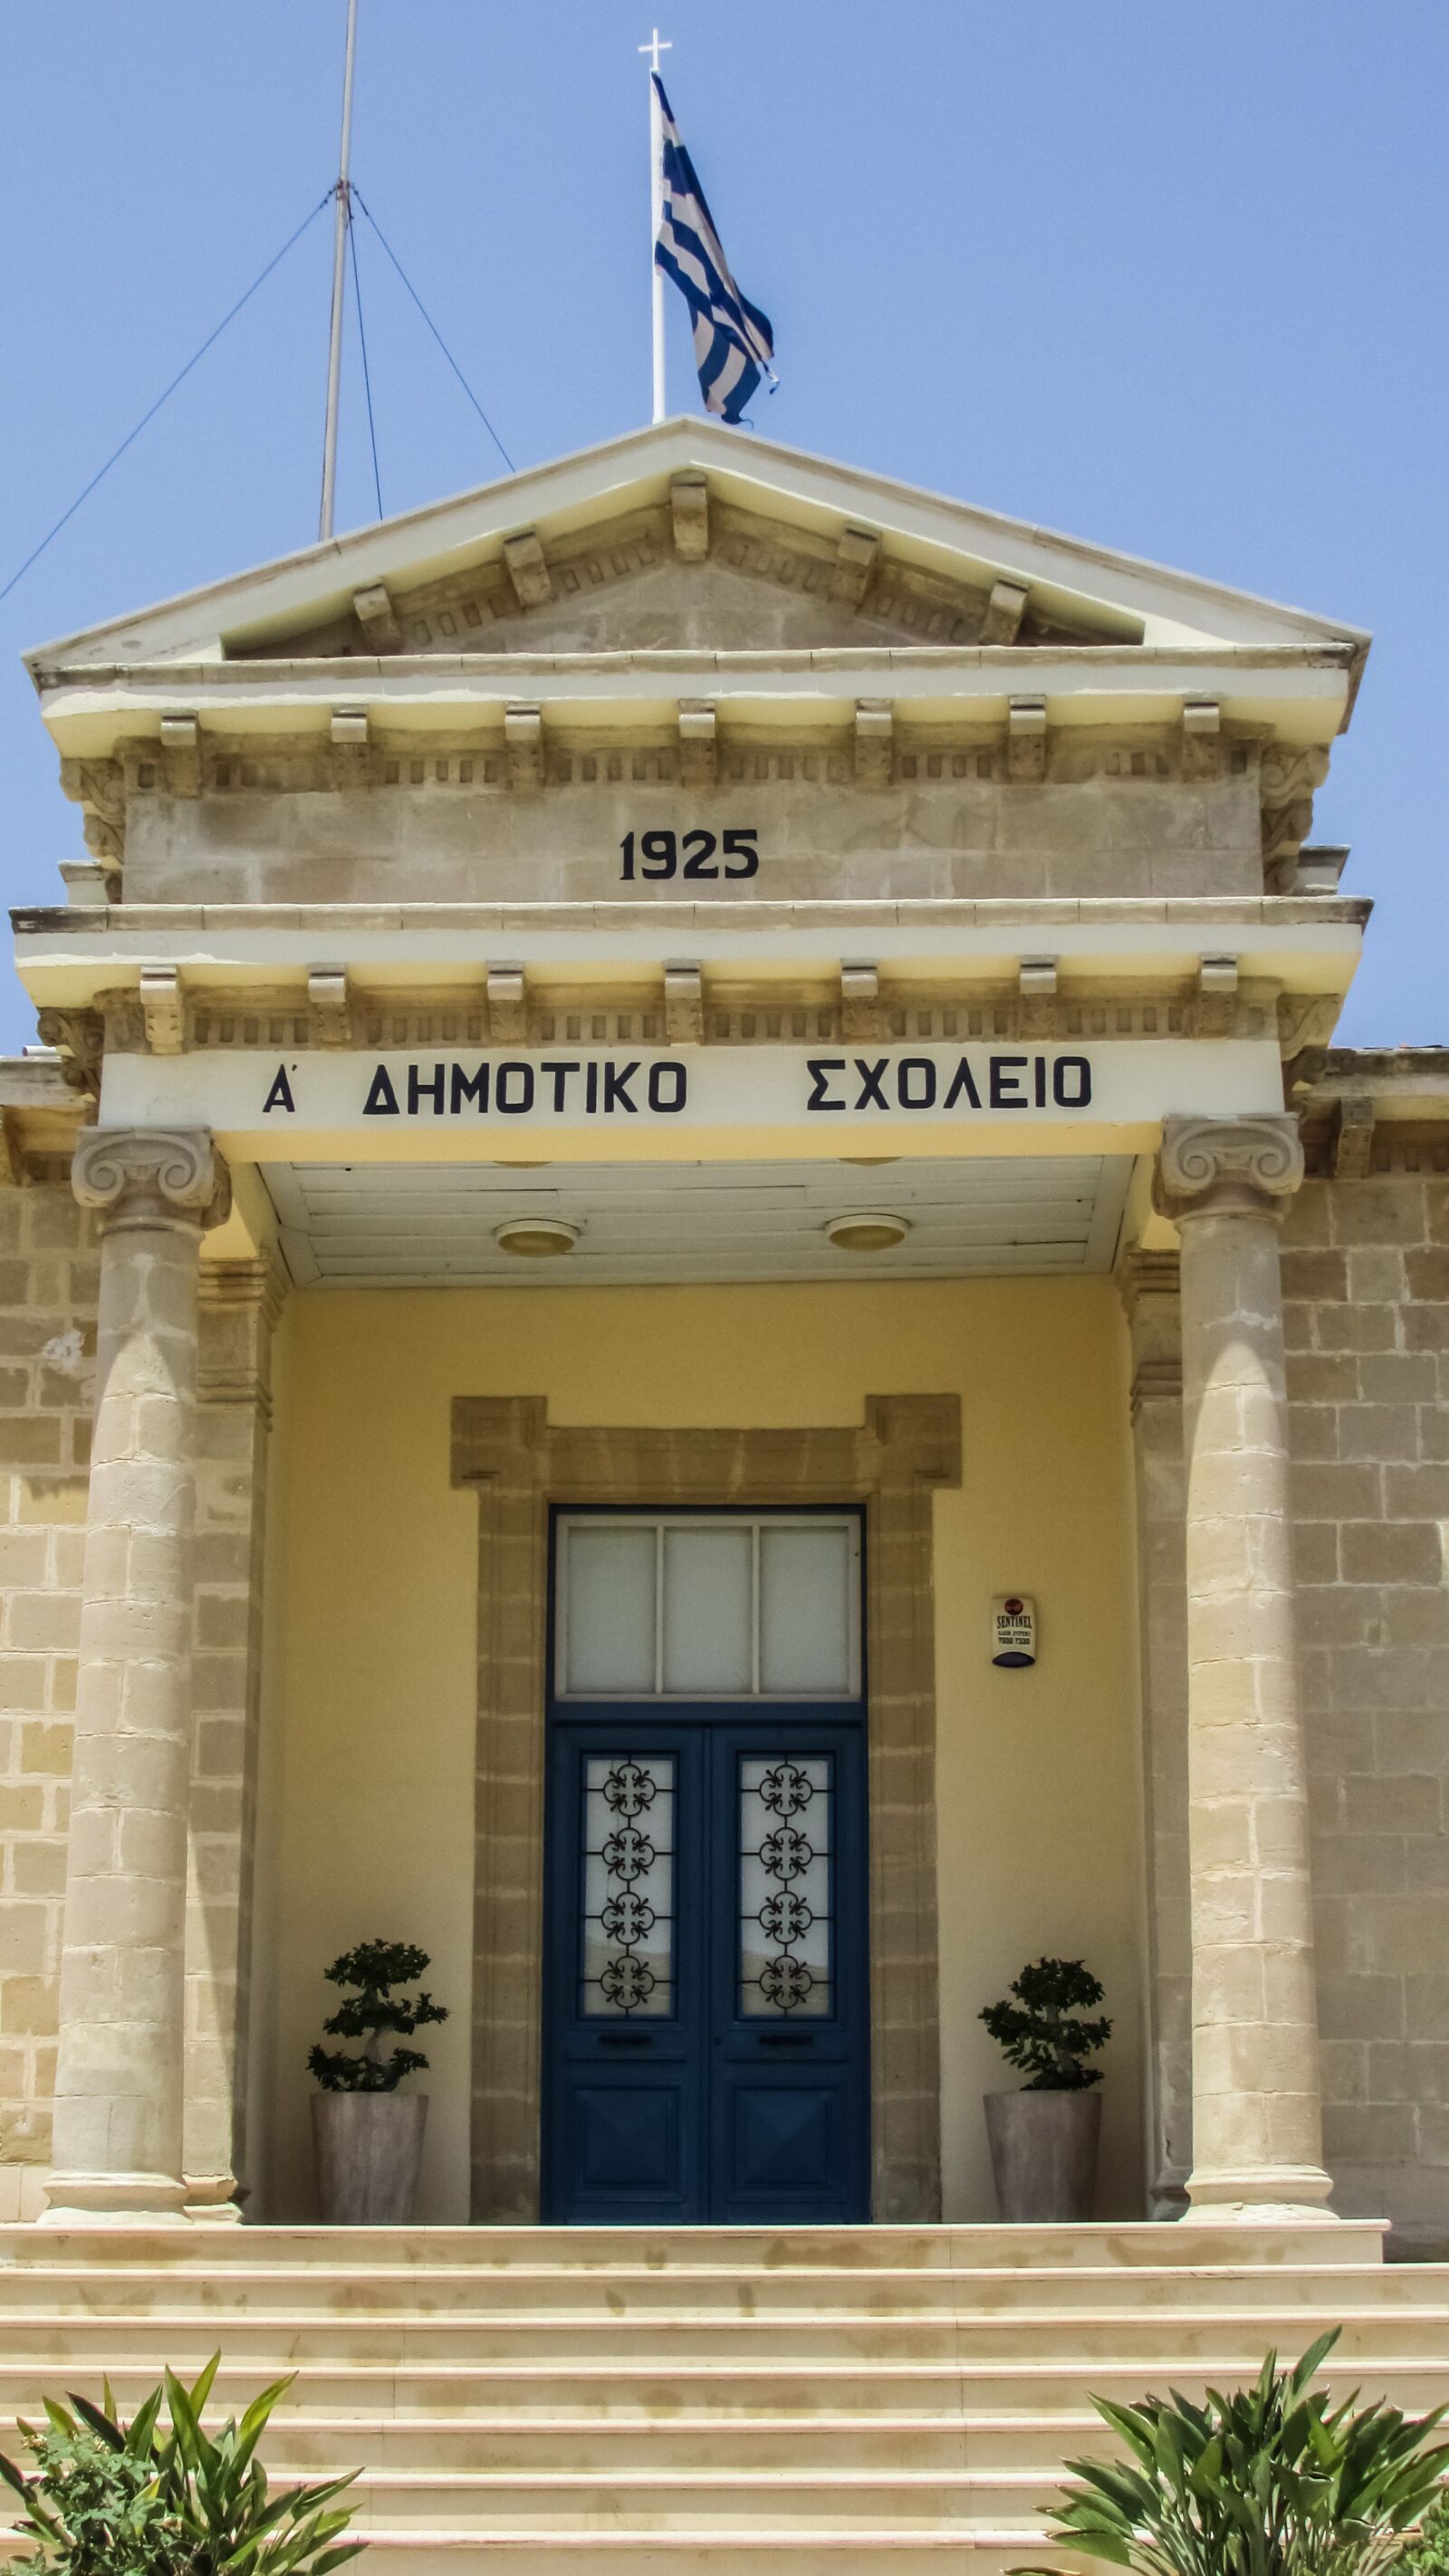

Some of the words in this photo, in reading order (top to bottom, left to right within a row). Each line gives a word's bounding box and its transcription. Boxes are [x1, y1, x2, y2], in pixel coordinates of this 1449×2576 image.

[619, 829, 760, 880] 1925
[362, 1062, 687, 1115] ΔΗΜΟΤΙΚΟ
[807, 1056, 1092, 1111] ΣΧΟΛΕΙΟ
[997, 1615, 1032, 1629] SENTINEL
